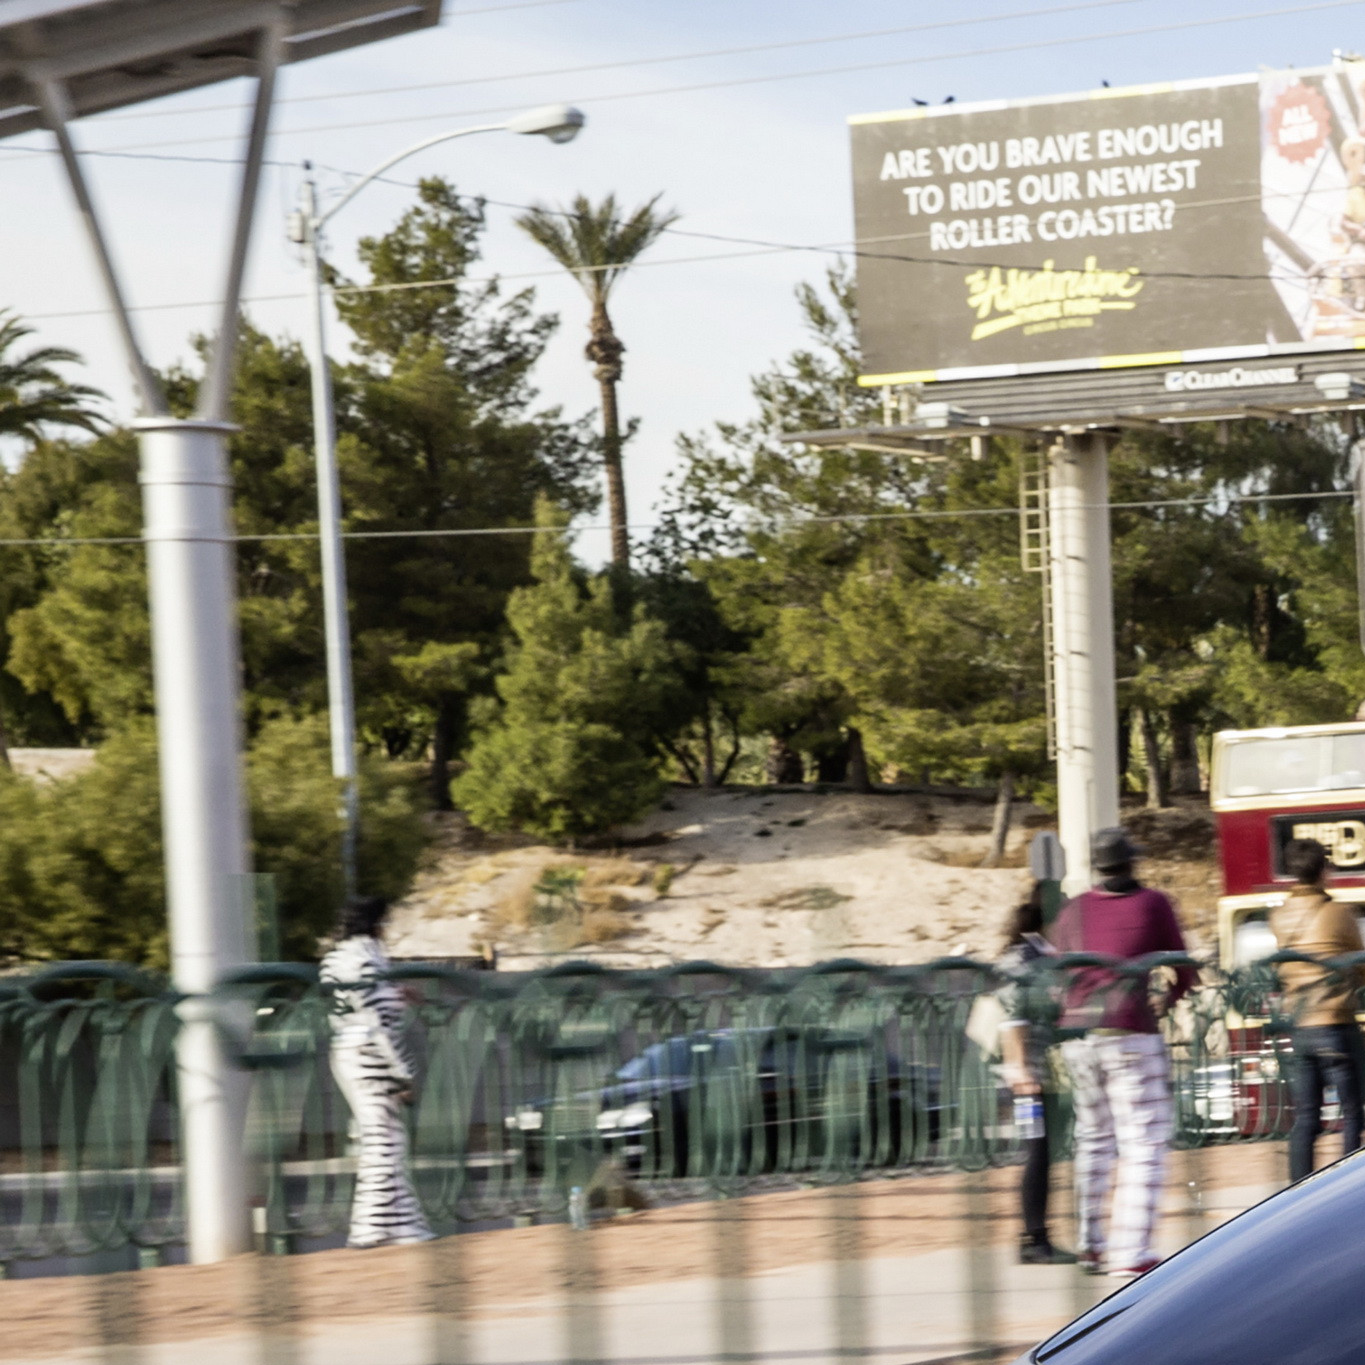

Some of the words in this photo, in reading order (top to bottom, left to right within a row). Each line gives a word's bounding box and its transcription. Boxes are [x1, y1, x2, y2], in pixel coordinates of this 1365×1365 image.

[880, 148, 933, 180] ARE
[938, 142, 999, 174] YOU
[1006, 131, 1093, 169] BRAVE
[1098, 118, 1223, 160] ENOUGH
[904, 184, 944, 216] TO
[949, 177, 1013, 212] RIDE
[1018, 171, 1082, 205] OUR
[1087, 159, 1201, 198] NEWEST
[930, 214, 1031, 251] ROLLER
[1037, 199, 1176, 241] COASTER?
